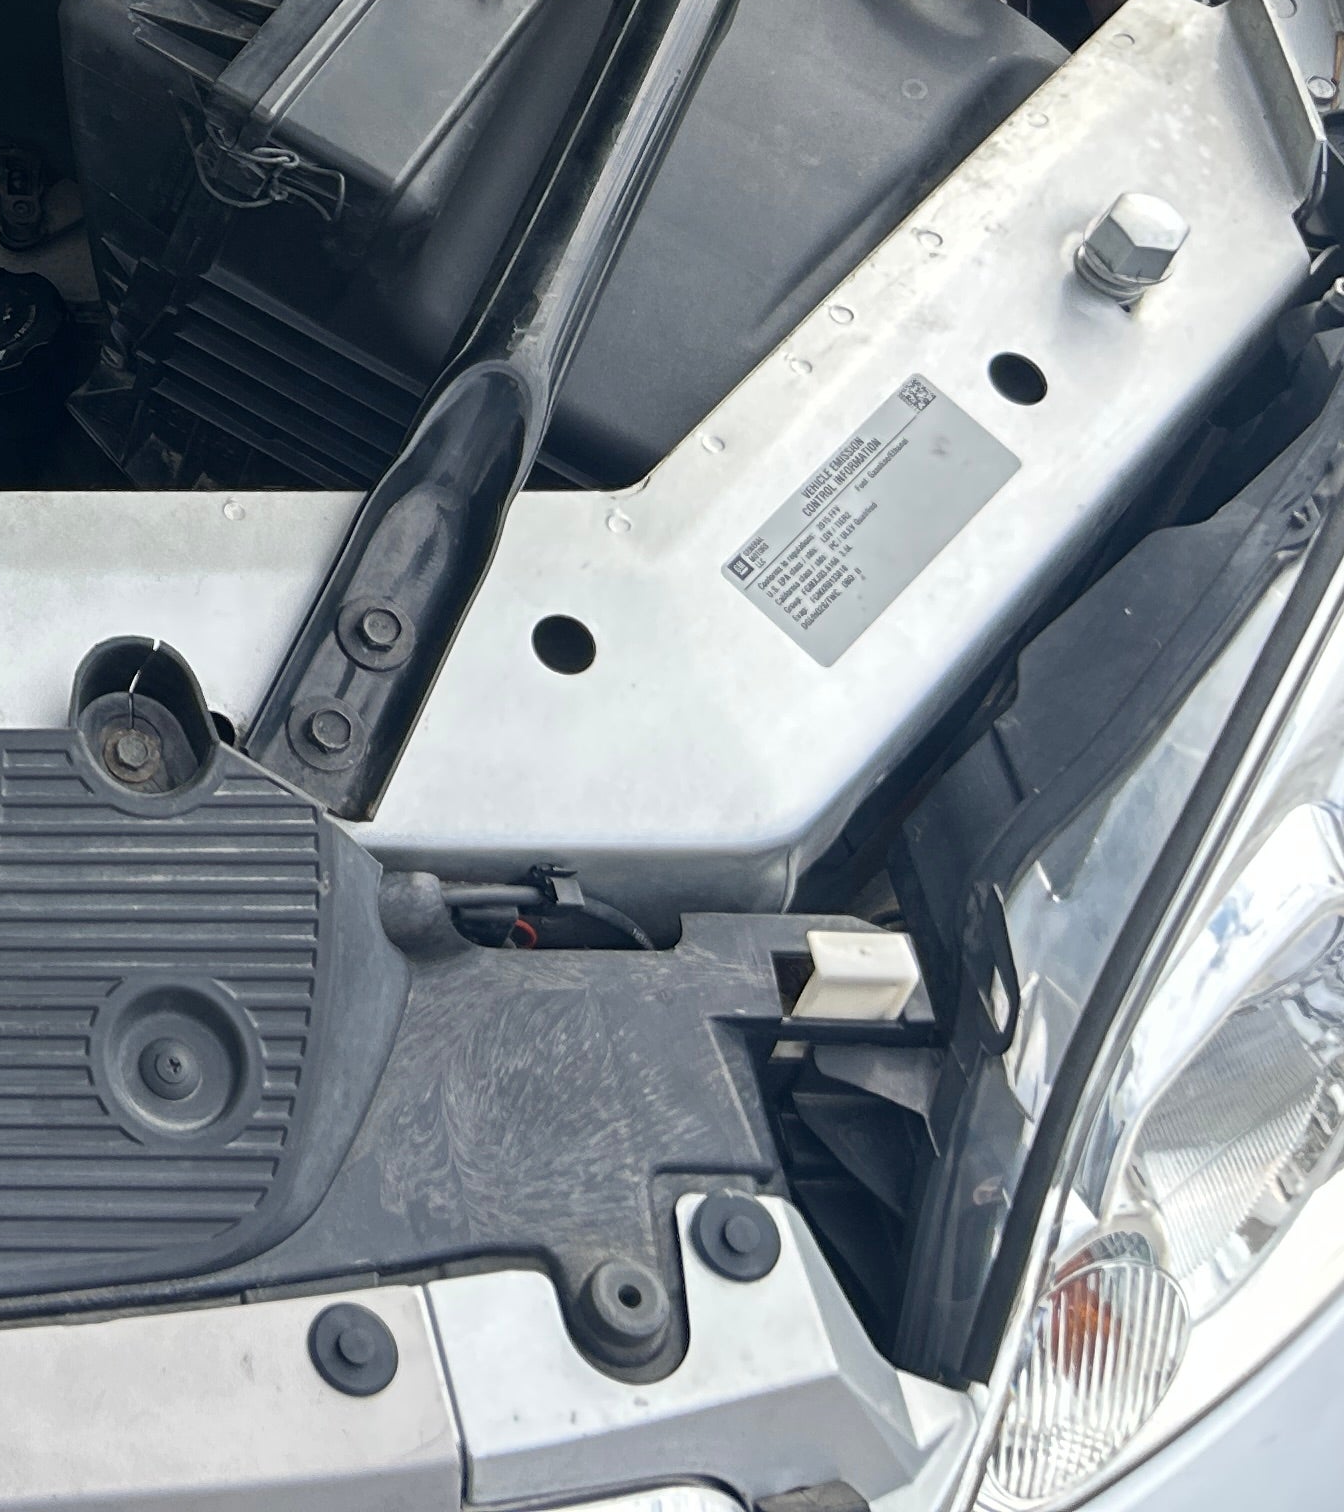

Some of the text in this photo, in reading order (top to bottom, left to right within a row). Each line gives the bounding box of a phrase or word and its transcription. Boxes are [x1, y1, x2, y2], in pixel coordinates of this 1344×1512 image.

[801, 436, 864, 499] VEHICLE EMISSION
[802, 437, 881, 517] CONTROL INFORMATION
[777, 572, 790, 586] EPA
[834, 511, 851, 528] TIER2
[840, 523, 856, 539] ULEV
